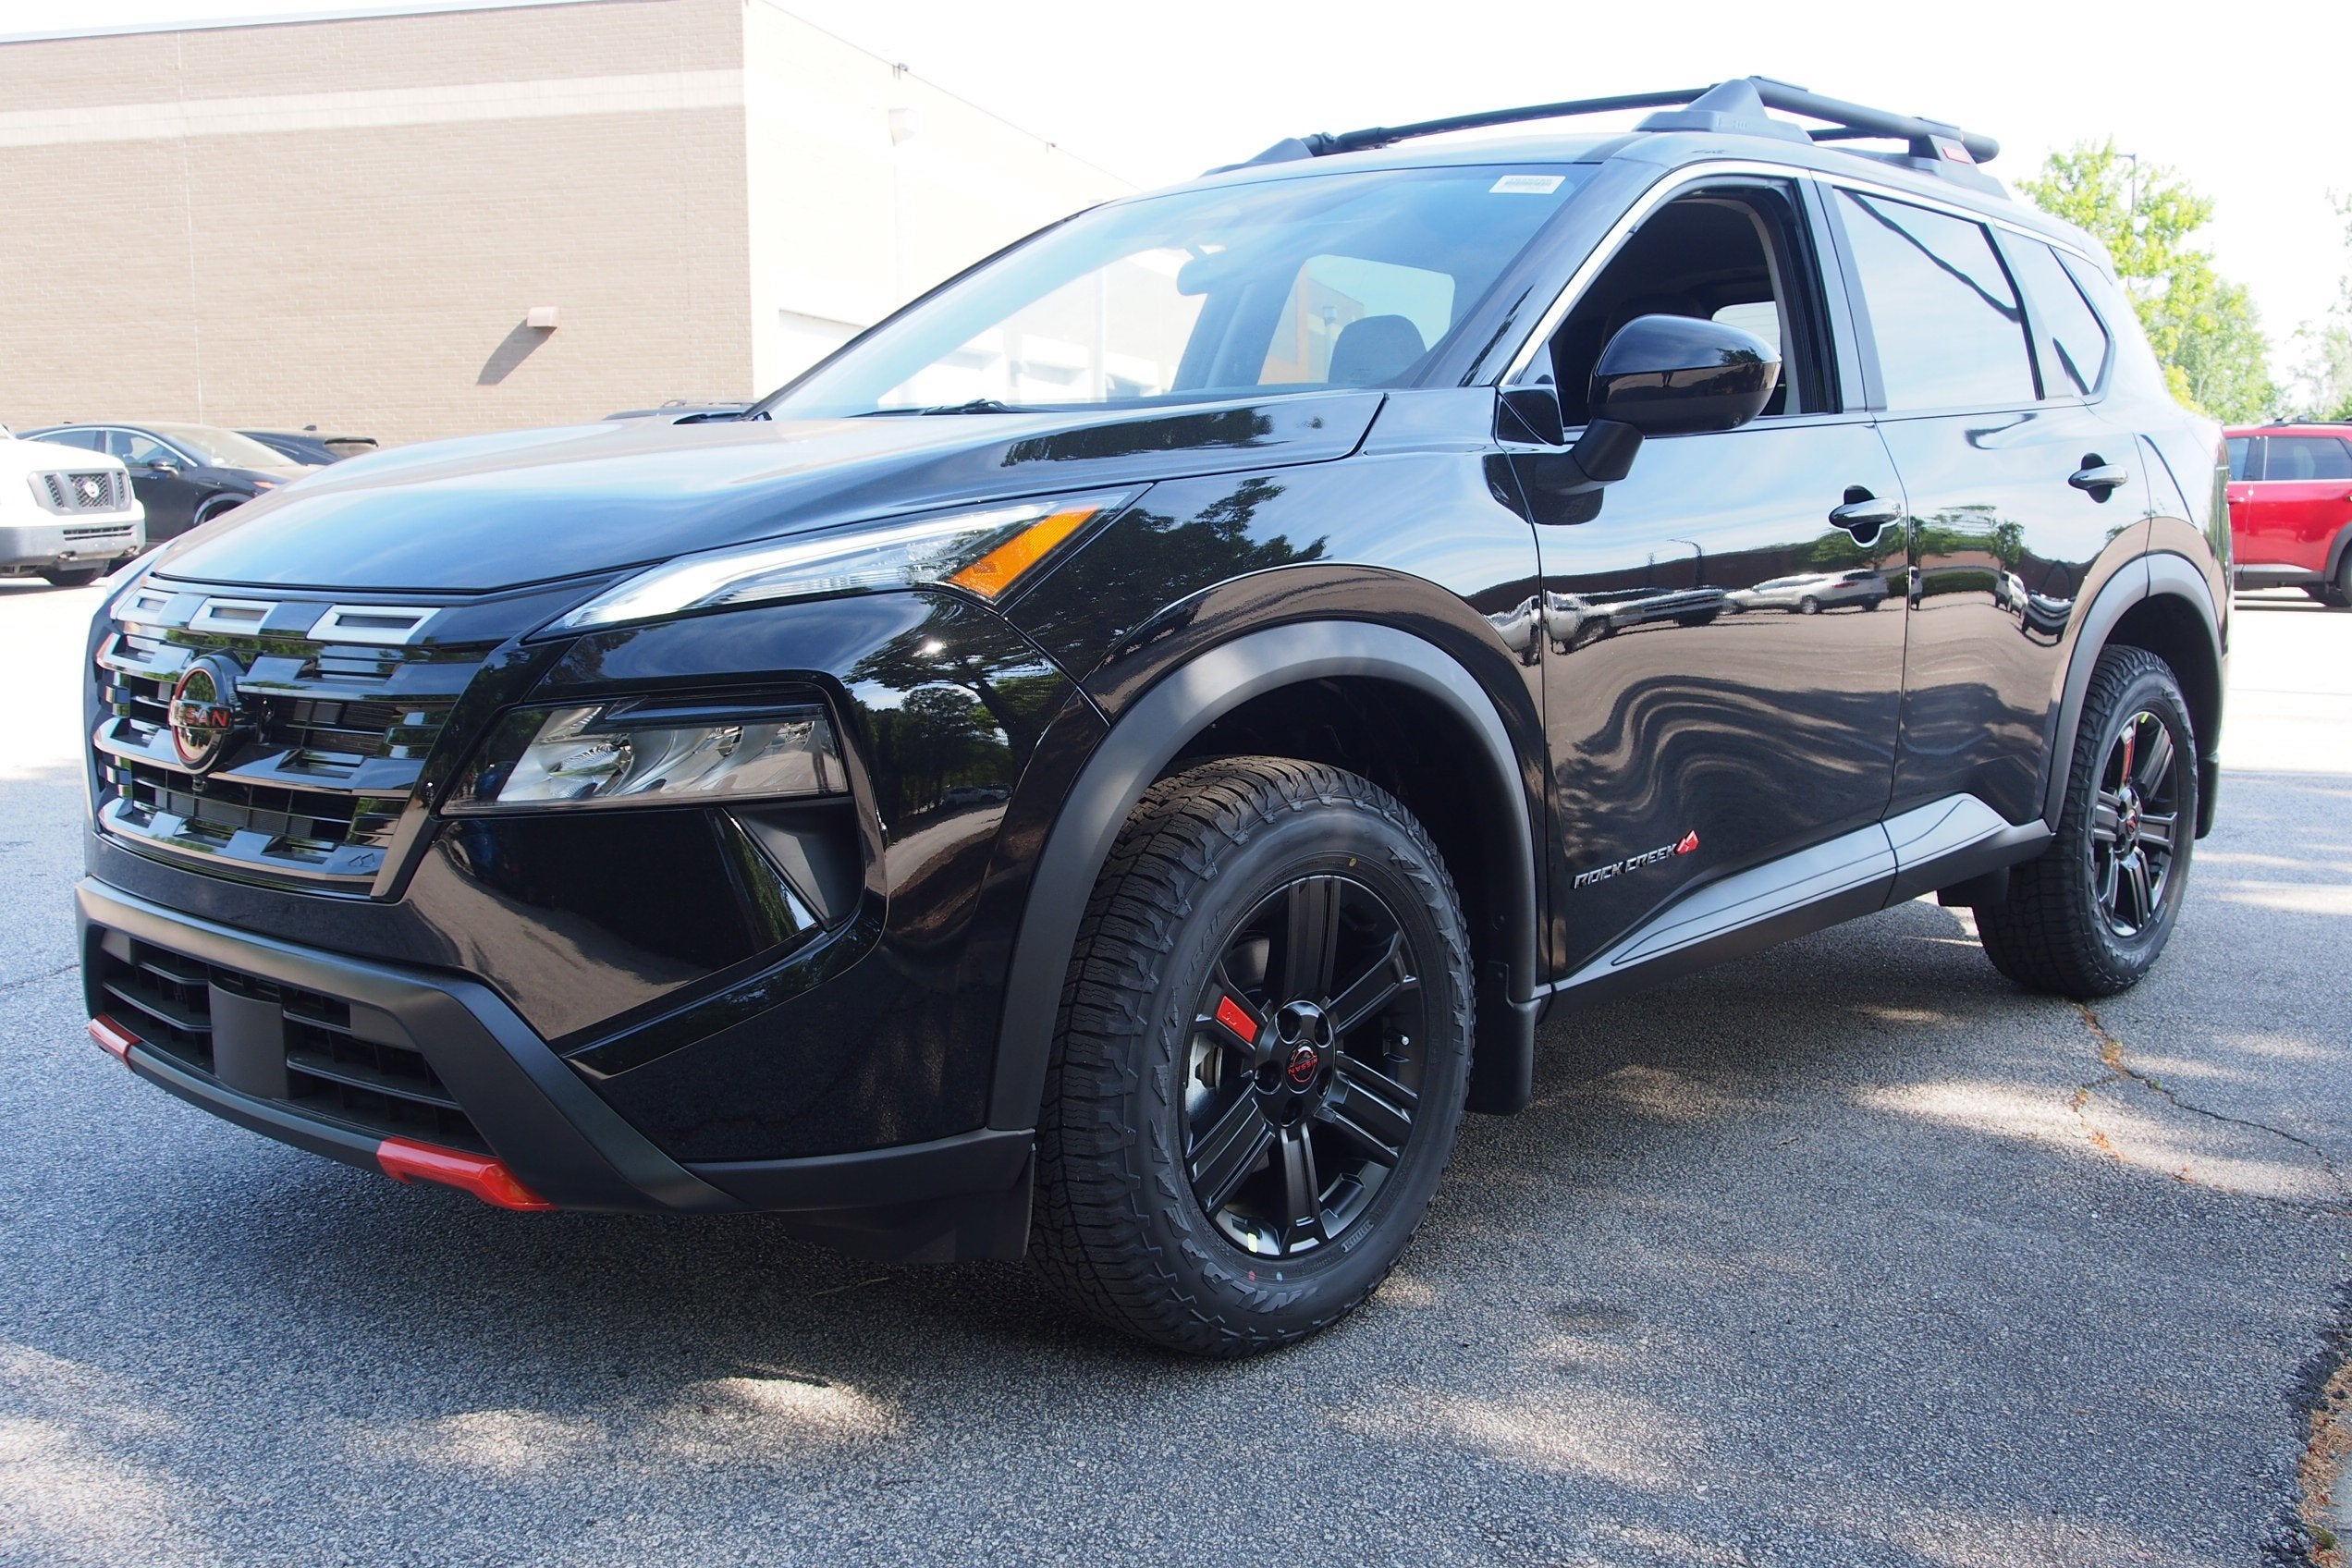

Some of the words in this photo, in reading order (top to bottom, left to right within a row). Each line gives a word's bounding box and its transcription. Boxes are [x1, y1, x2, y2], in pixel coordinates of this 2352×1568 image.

[1573, 862, 1624, 889] ROCK
[1624, 843, 1677, 873] CREEK
[1287, 1057, 1318, 1075] NISSAN
